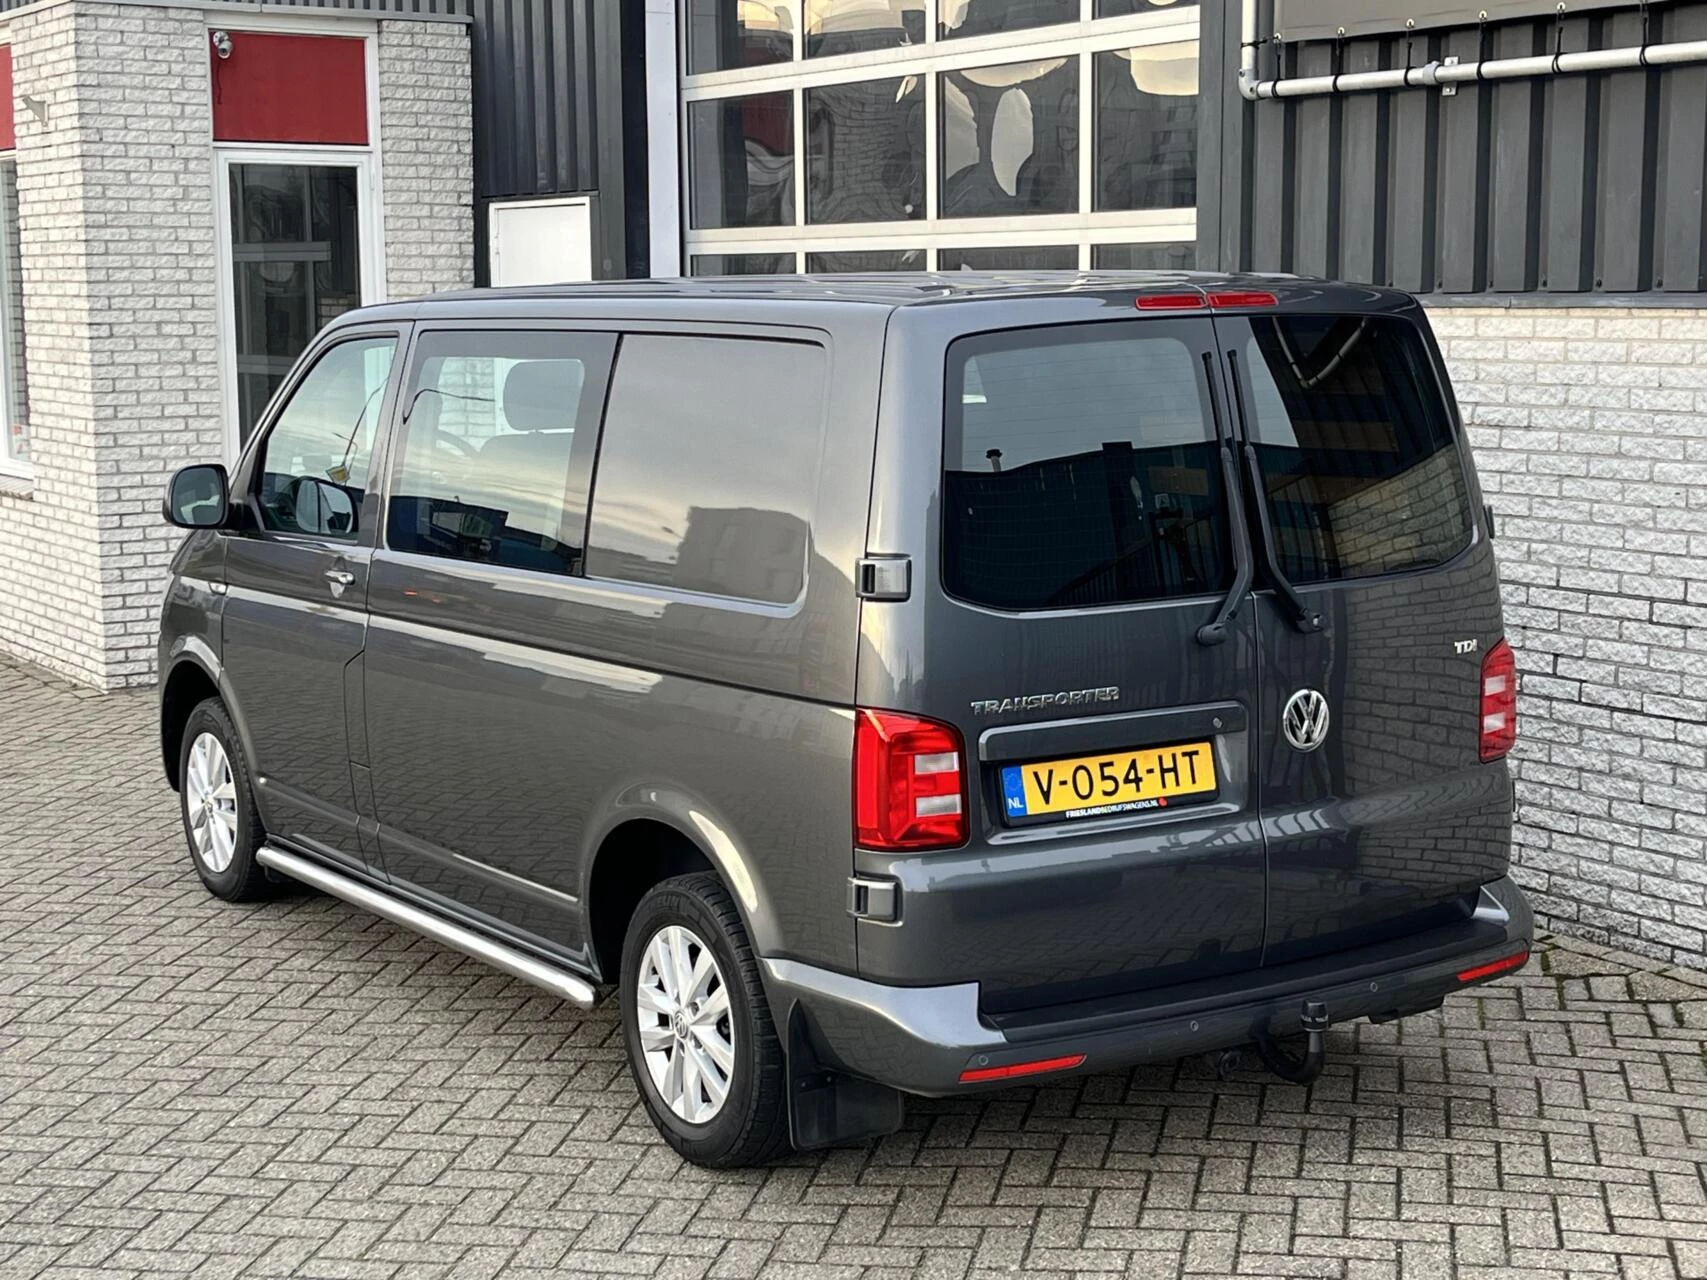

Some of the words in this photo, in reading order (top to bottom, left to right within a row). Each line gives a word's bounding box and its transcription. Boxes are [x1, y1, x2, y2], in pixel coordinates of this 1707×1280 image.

[1454, 639, 1478, 654] TDI
[970, 686, 1120, 716] TRANSPORTER
[1032, 750, 1200, 806] V-054-HT
[1007, 797, 1024, 810] NL
